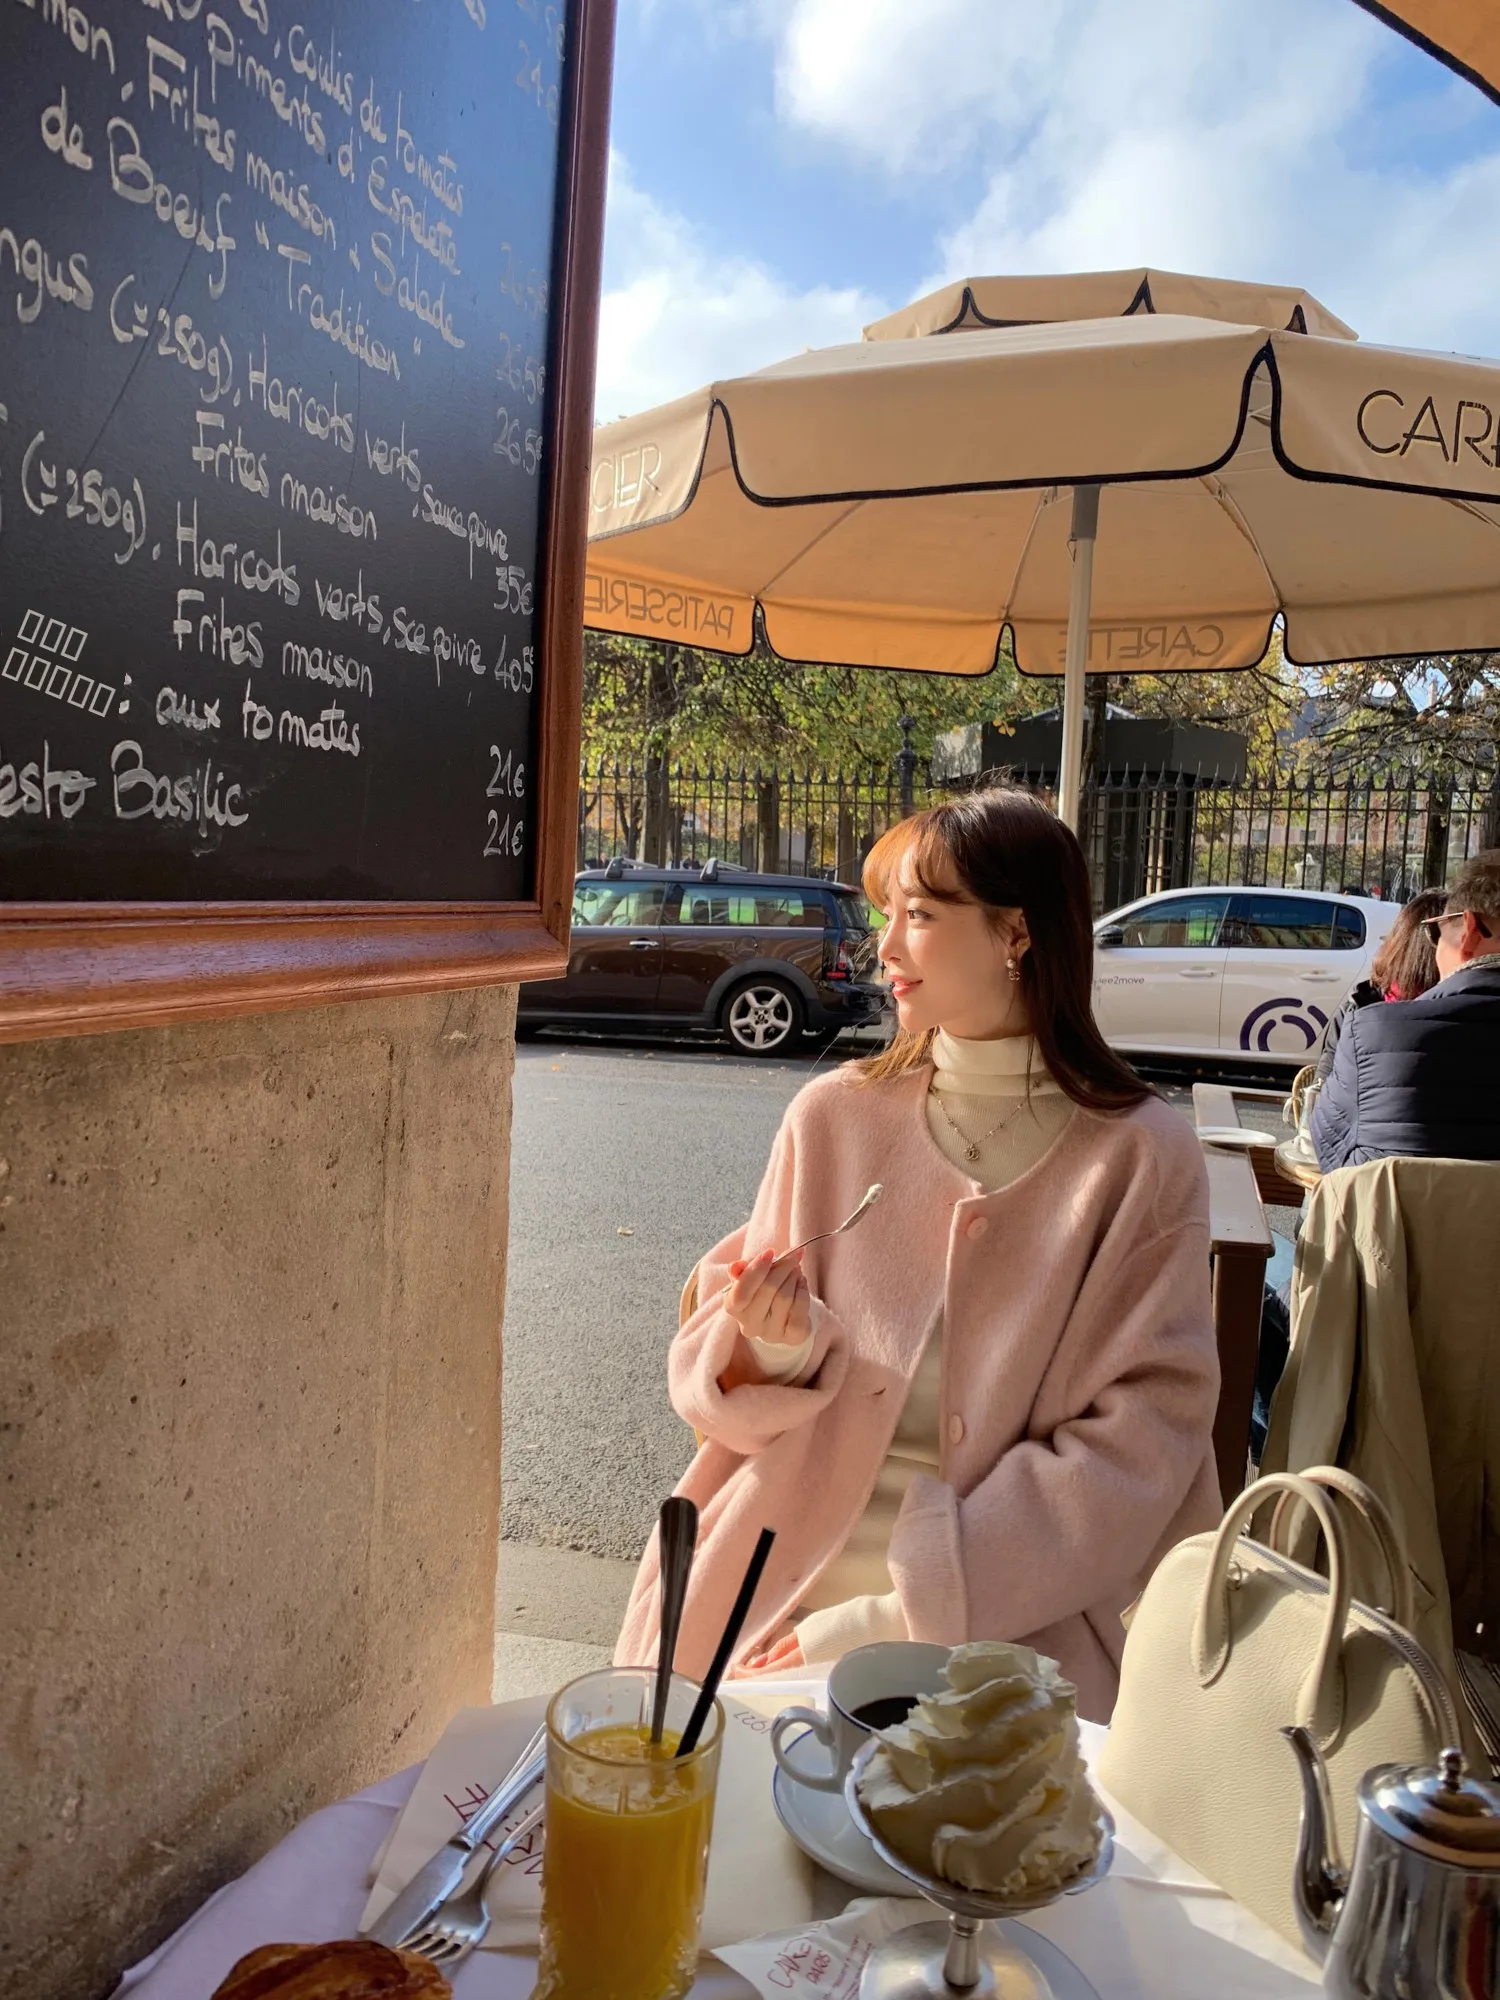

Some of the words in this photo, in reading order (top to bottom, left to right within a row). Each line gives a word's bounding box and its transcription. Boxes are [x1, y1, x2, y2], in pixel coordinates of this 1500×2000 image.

[206, 12, 326, 155] Piments
[106, 116, 236, 298] Boeuf
[247, 151, 336, 250] maison
[371, 232, 465, 348] Salade
[0, 227, 94, 323] ngus
[249, 332, 354, 453] Haricots
[192, 411, 270, 498] Frites
[281, 473, 377, 541] maison
[590, 443, 662, 513] CIER
[1357, 389, 1500, 468] CAR
[173, 588, 264, 668] Frites
[281, 641, 373, 698] maison
[176, 498, 300, 606] Haricots
[433, 626, 487, 688] poivre
[493, 565, 534, 616] 35€
[156, 686, 221, 731] aux
[242, 678, 361, 756] tomates
[486, 744, 525, 797] 21€
[0, 739, 97, 818] esto
[111, 739, 249, 838] Basilic
[483, 811, 523, 858] 21€
[1097, 975, 1145, 985] ee2move
